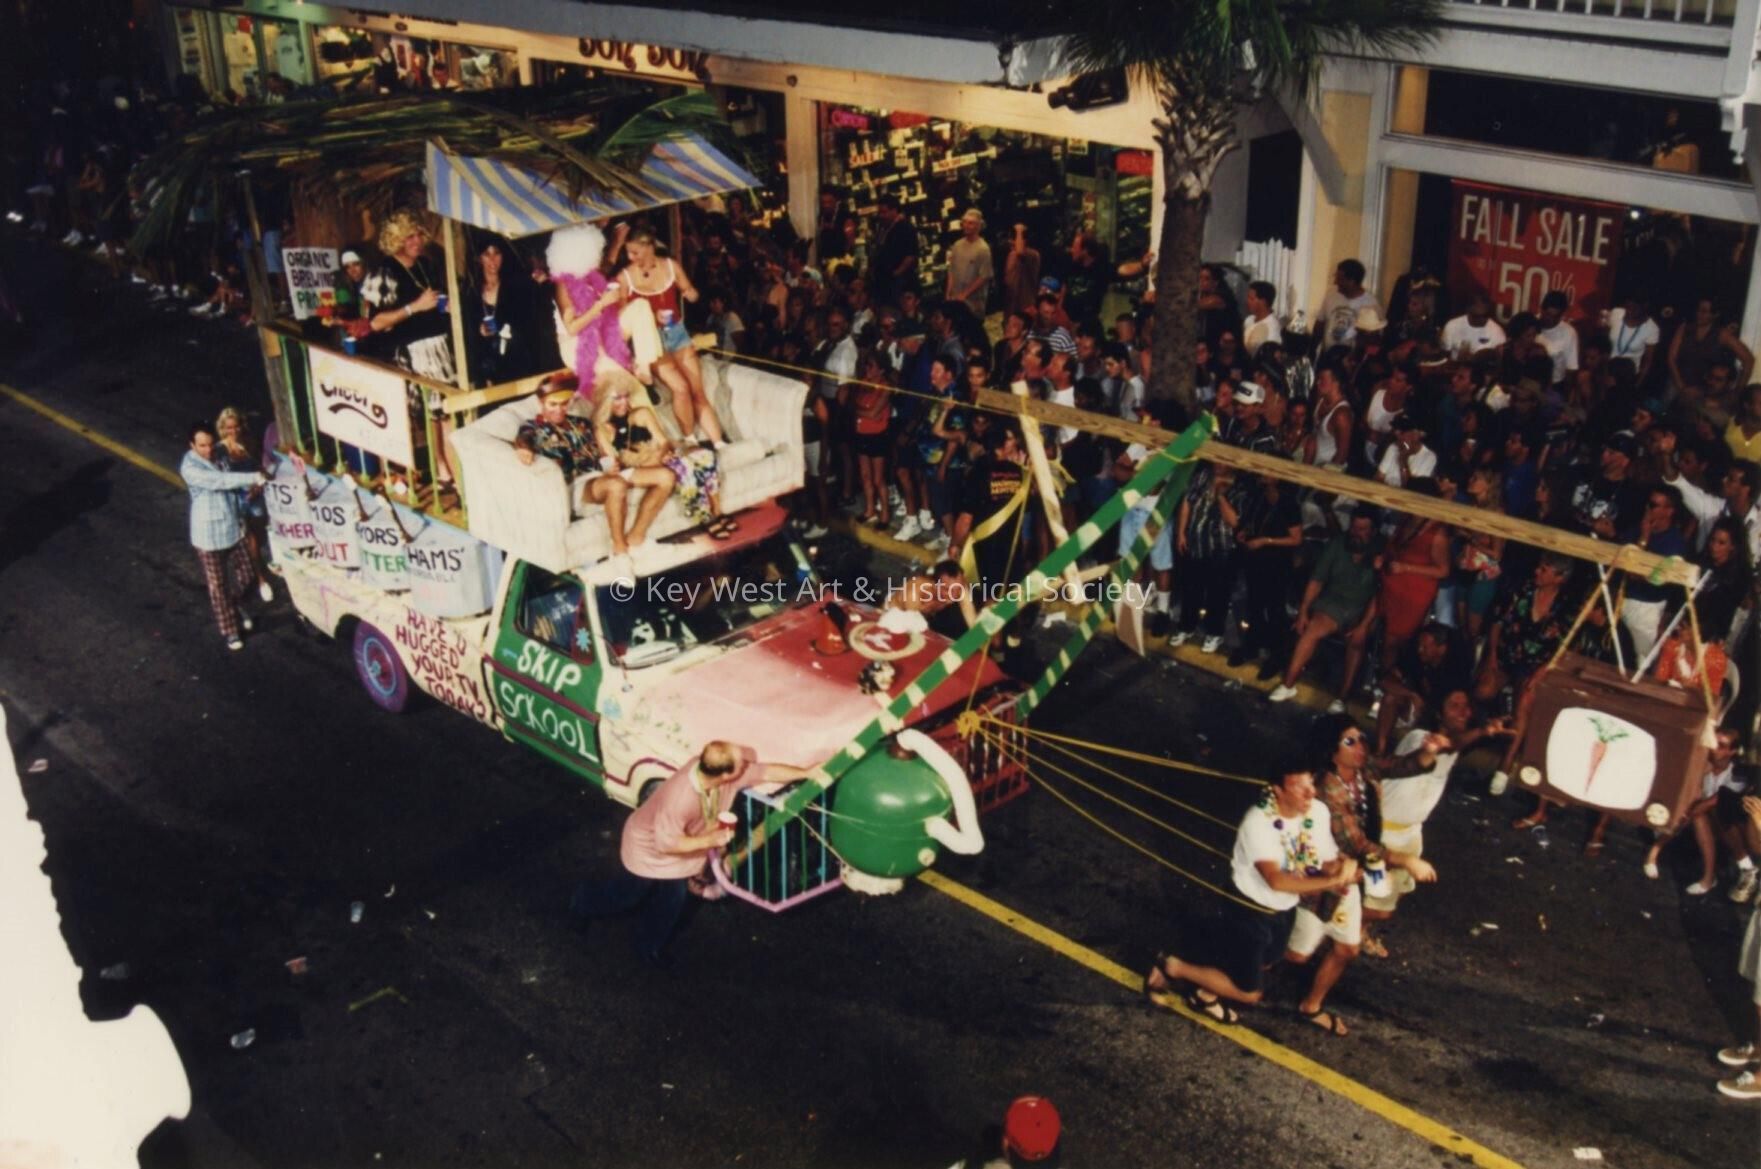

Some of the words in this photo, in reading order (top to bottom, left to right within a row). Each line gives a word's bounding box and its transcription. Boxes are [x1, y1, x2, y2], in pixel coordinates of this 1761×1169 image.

[1460, 194, 1524, 250] FALL
[1536, 206, 1613, 265] SALE
[286, 251, 332, 270] ORGANIC
[396, 624, 459, 669] HUGGED
[517, 639, 581, 693] SKIP
